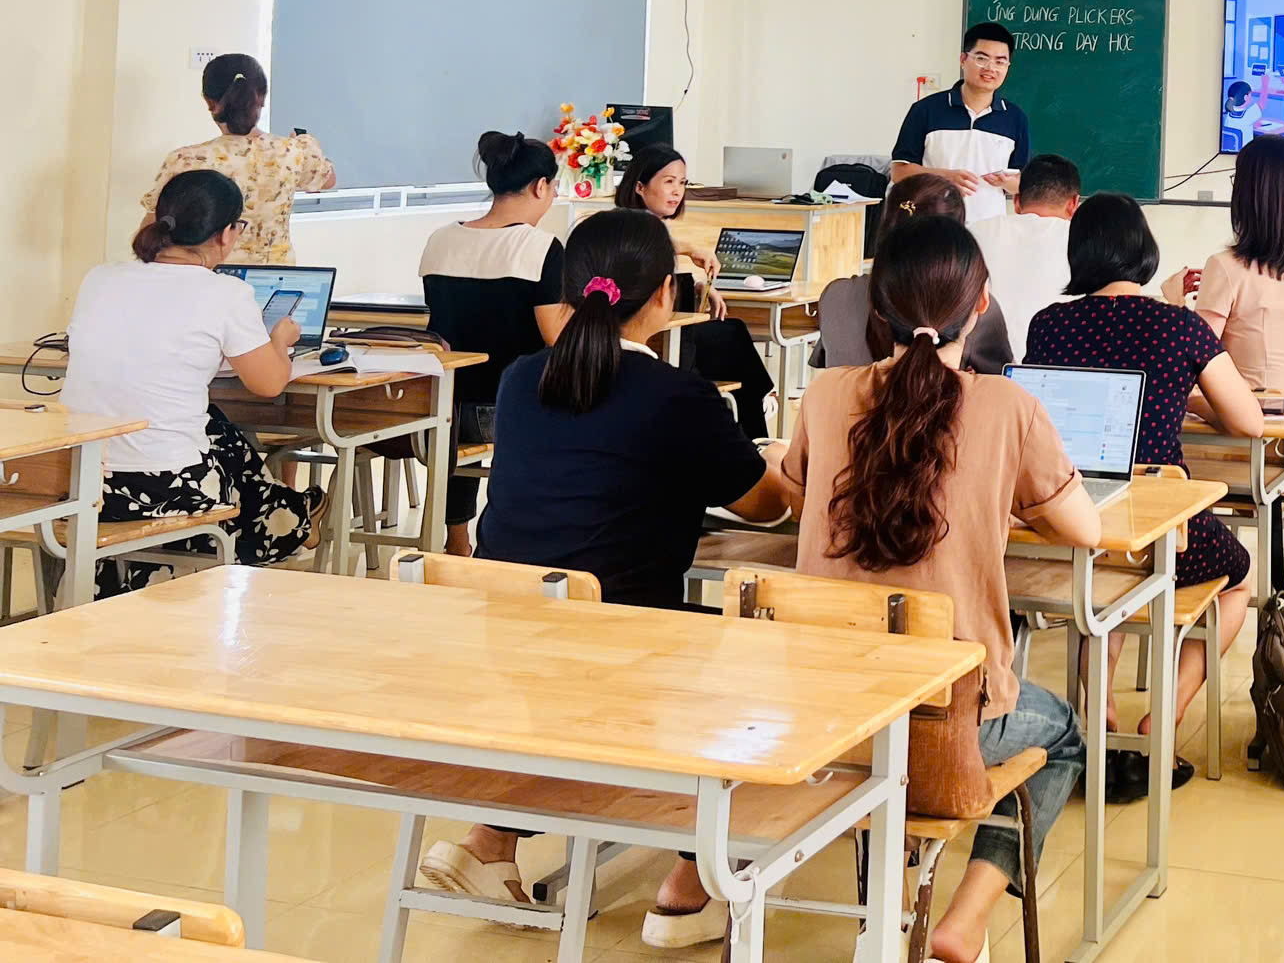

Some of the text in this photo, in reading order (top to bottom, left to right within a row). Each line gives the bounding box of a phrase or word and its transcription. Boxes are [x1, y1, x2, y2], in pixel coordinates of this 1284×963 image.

[987, 0, 1016, 22] ỨNG
[1068, 6, 1135, 25] PLICKERS
[1012, 32, 1067, 51] TRONG
